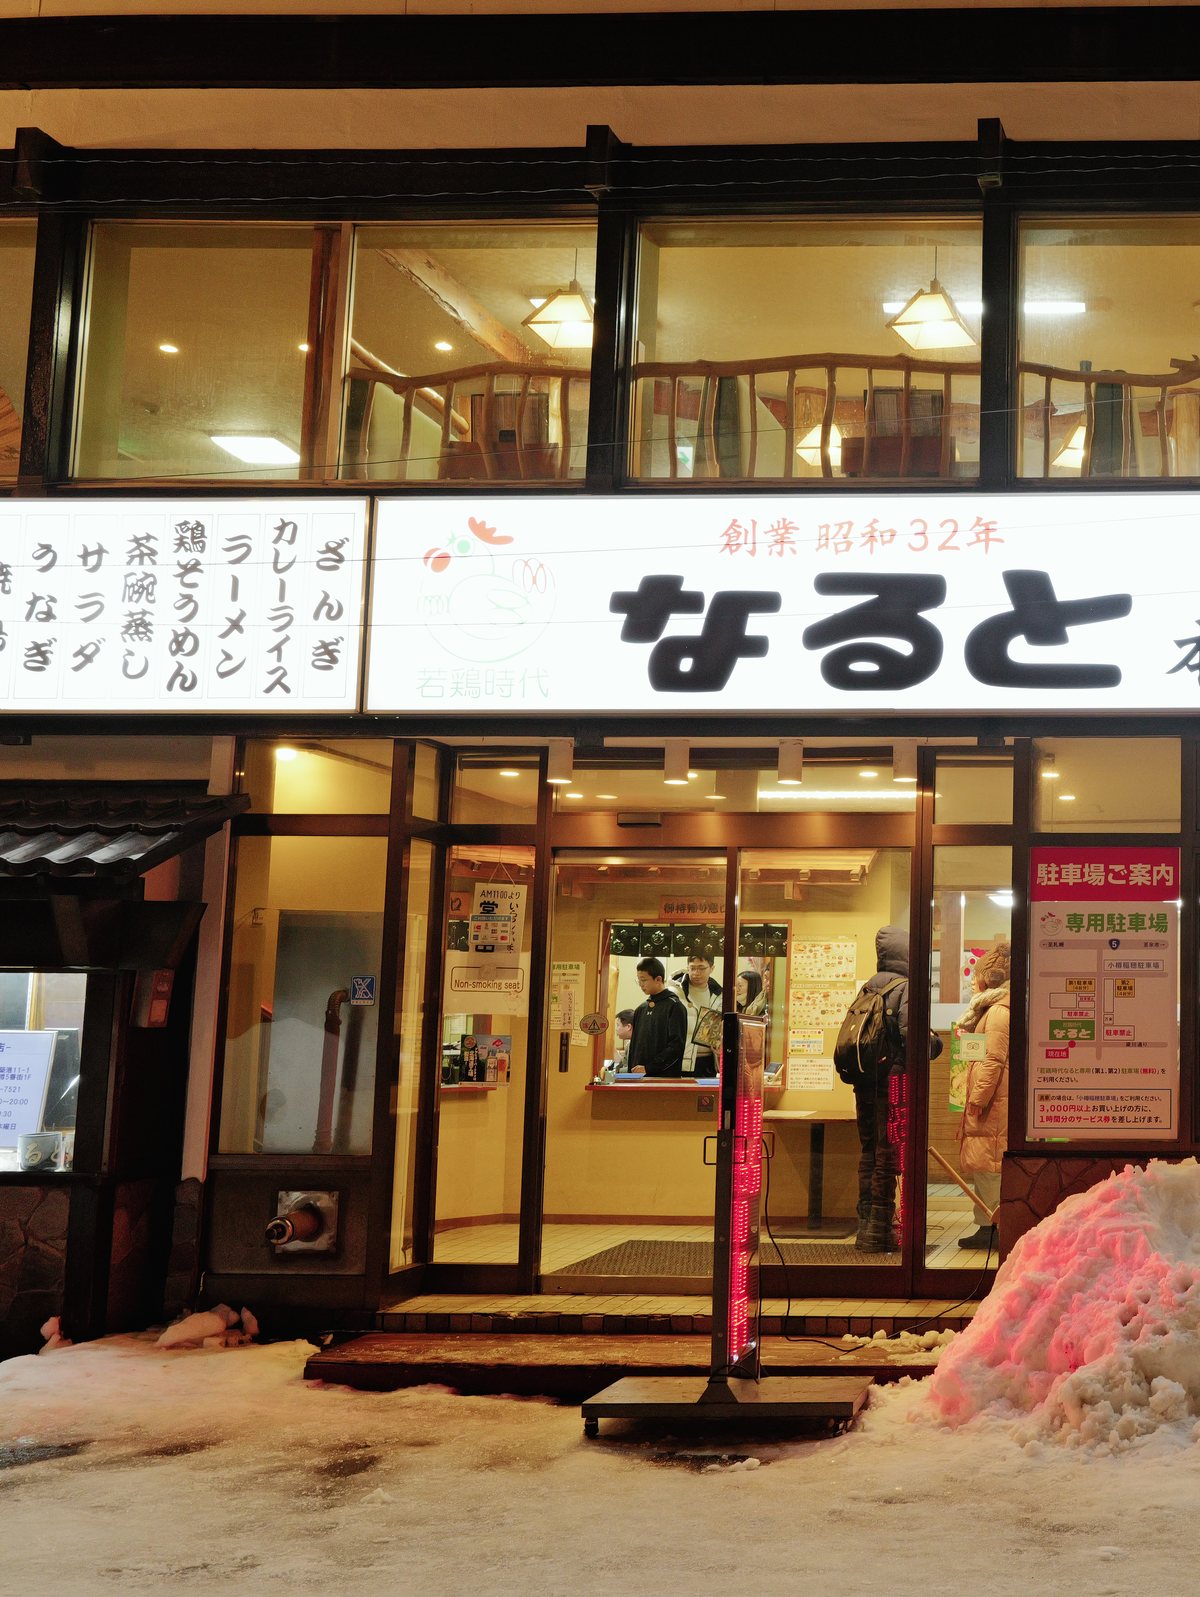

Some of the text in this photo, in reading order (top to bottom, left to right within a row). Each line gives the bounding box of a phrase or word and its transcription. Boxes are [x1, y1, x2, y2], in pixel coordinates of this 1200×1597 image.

[718, 517, 1007, 556] 創業 昭和32年
[23, 542, 58, 672] うなぎ
[71, 542, 110, 672] サラダ
[121, 532, 159, 680] 茶碗蒸し
[166, 519, 208, 693] 鶏そうめん
[215, 533, 253, 680] ラーメン
[263, 517, 299, 695] カレーライス
[311, 537, 350, 671] ざんぎ
[608, 569, 1133, 693] なると
[416, 667, 549, 699] 若鶏時代
[1036, 863, 1174, 886] 駐車場ご案内
[1066, 912, 1168, 933] 専用駐車場
[455, 980, 520, 990] Non-smoking seat
[1053, 1028, 1091, 1039] なると
